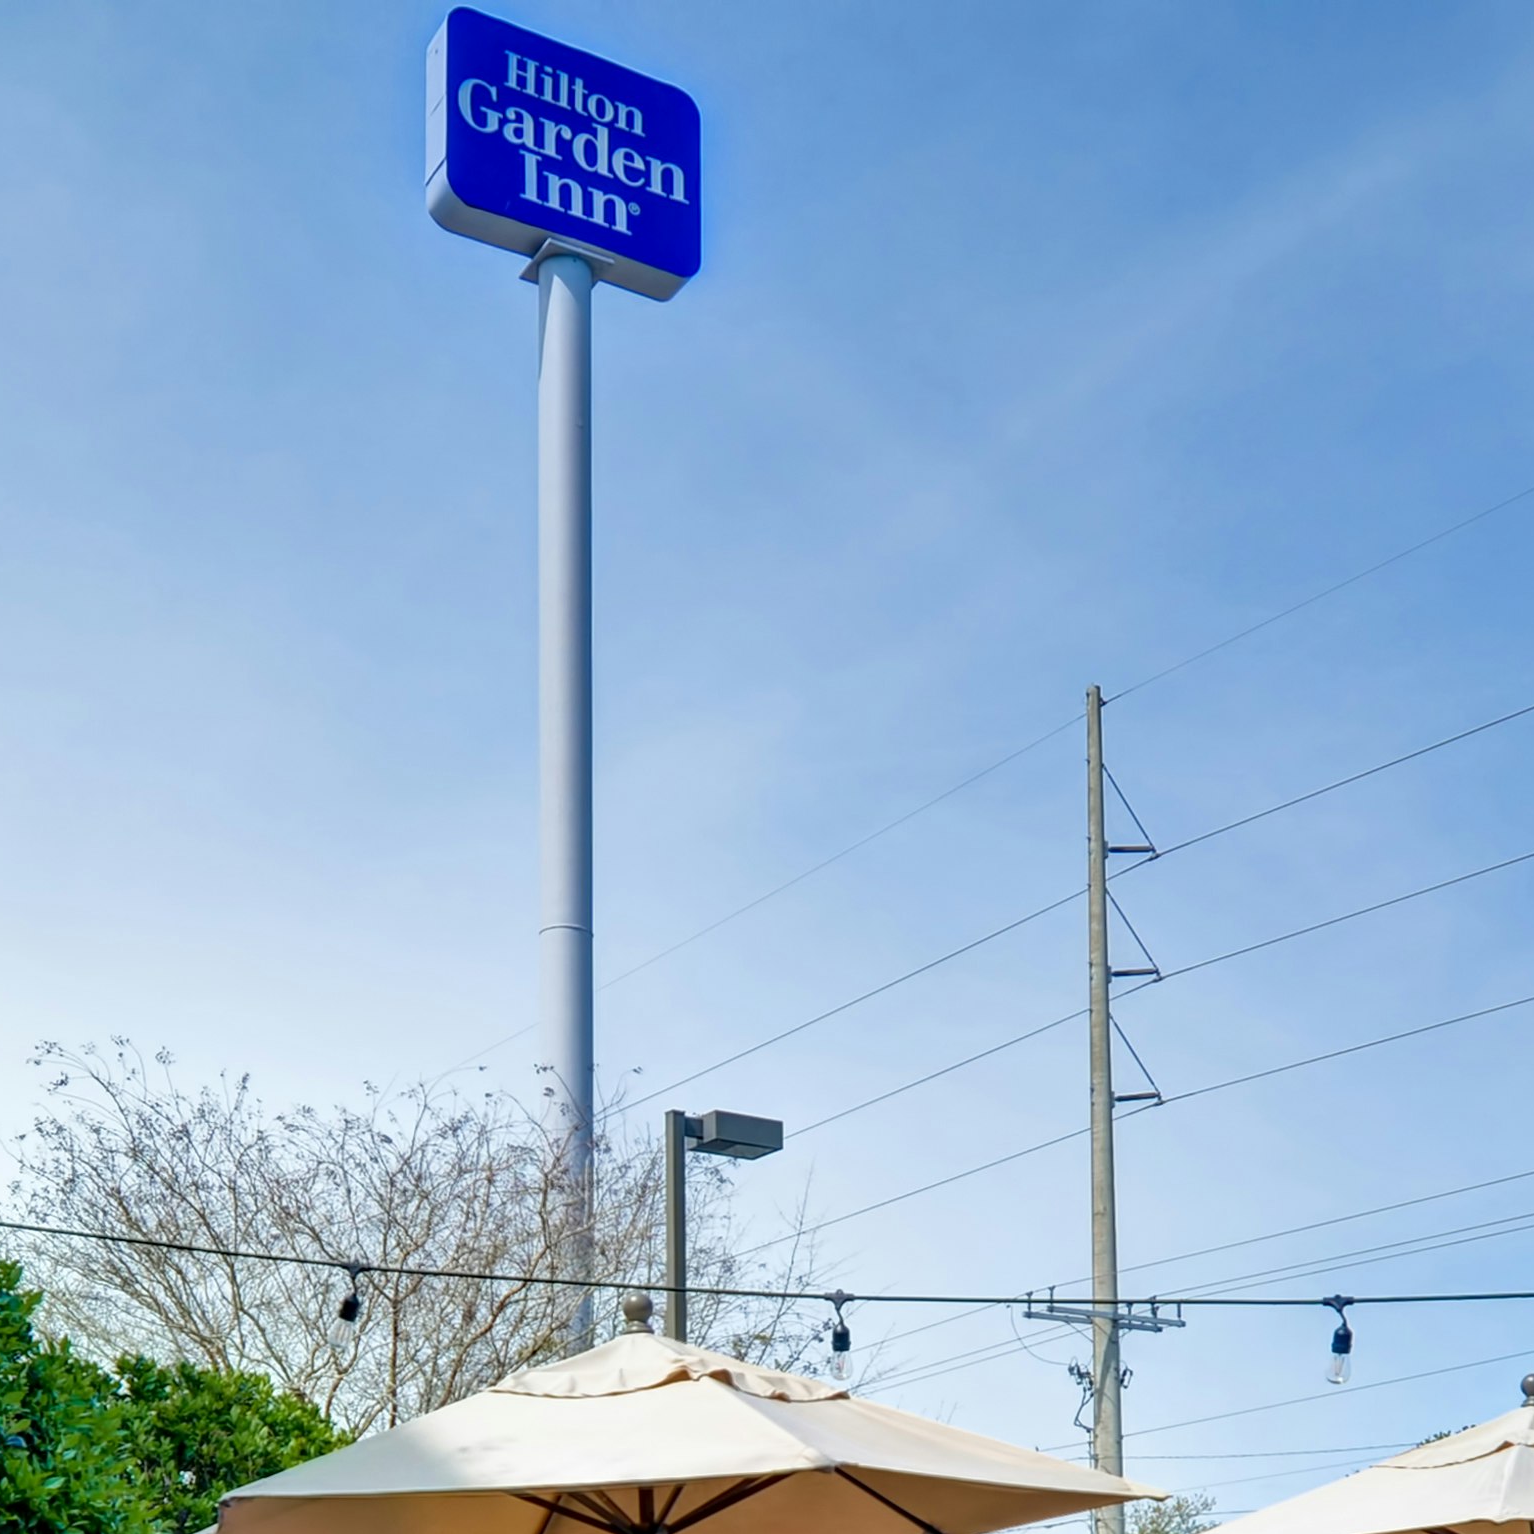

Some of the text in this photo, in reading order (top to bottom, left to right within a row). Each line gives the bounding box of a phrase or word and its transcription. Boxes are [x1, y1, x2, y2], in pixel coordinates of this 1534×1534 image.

[504, 50, 646, 138] Hilton
[458, 77, 690, 205] Garden
[519, 150, 633, 236] Inn
